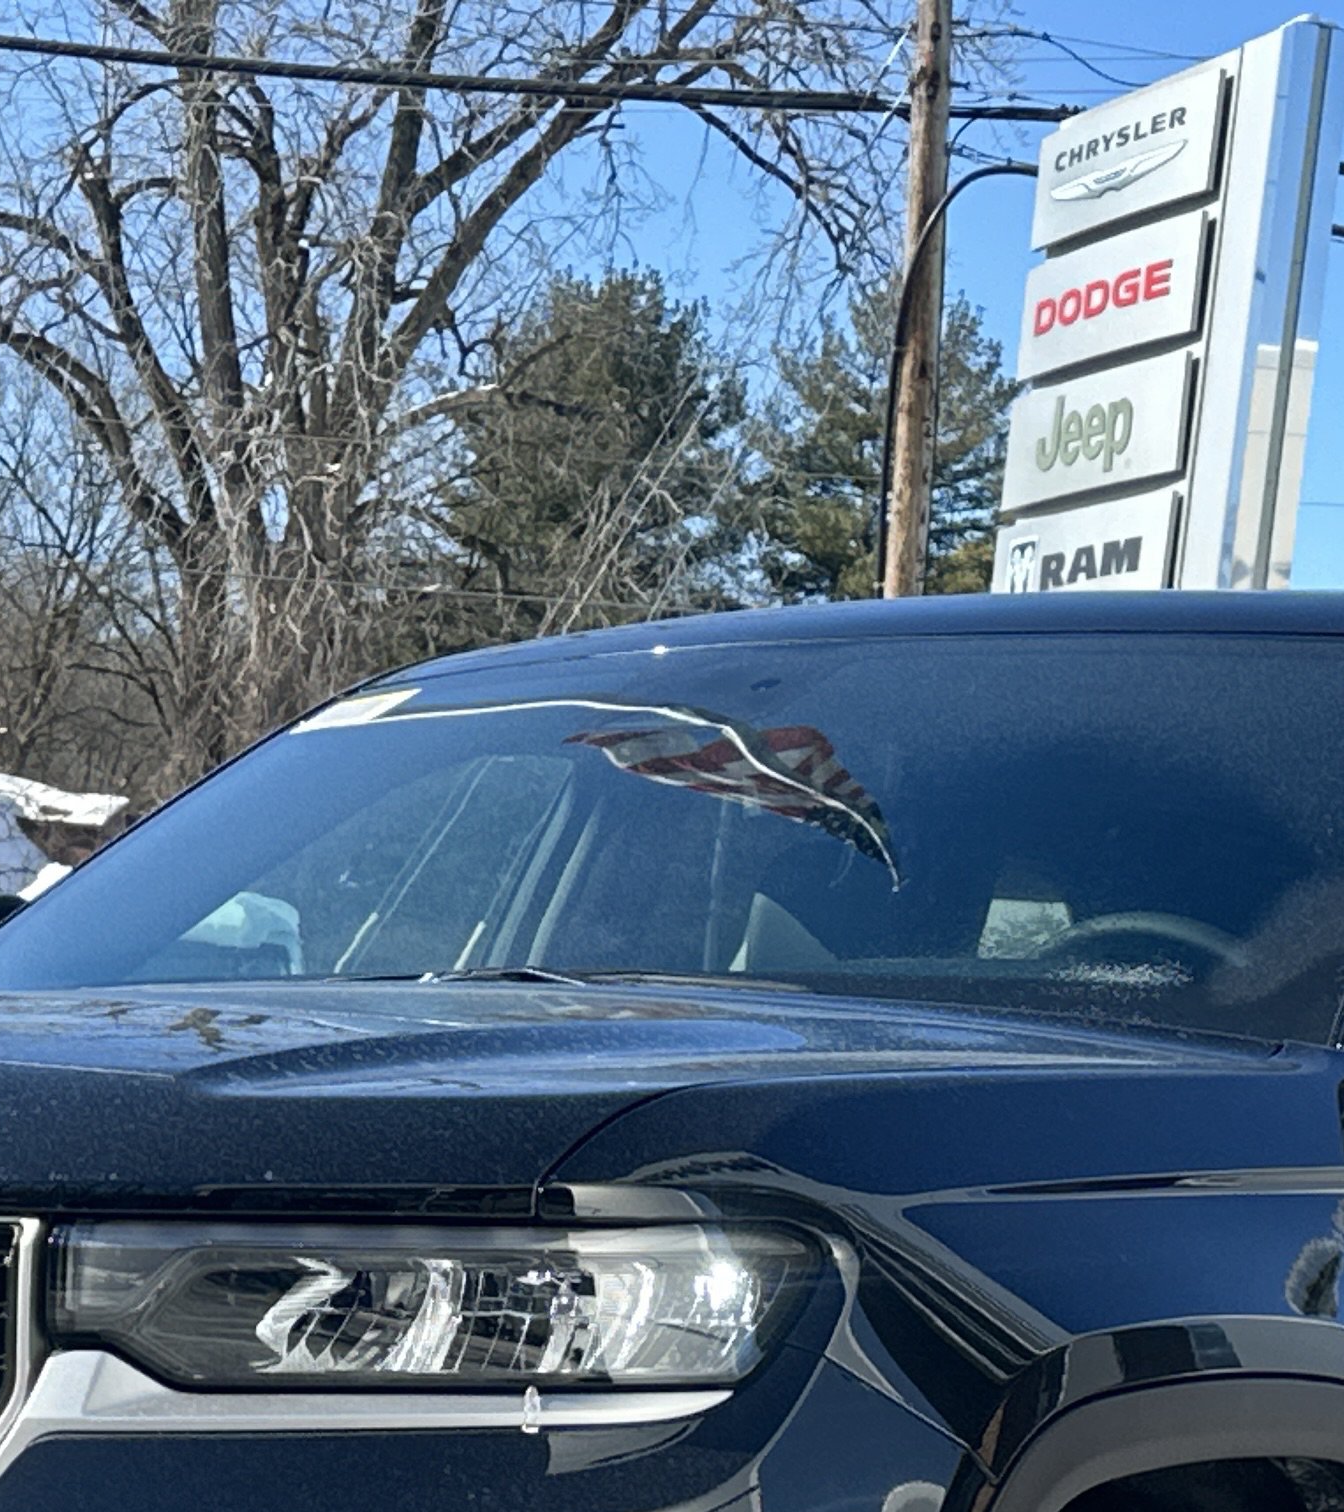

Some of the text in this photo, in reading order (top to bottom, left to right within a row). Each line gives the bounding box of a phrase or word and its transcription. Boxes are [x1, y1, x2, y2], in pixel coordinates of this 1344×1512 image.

[1054, 107, 1187, 172] CHRYSLER
[1032, 258, 1173, 337] DODGE
[1035, 395, 1133, 472] Jeep
[1039, 536, 1143, 591] RAM
